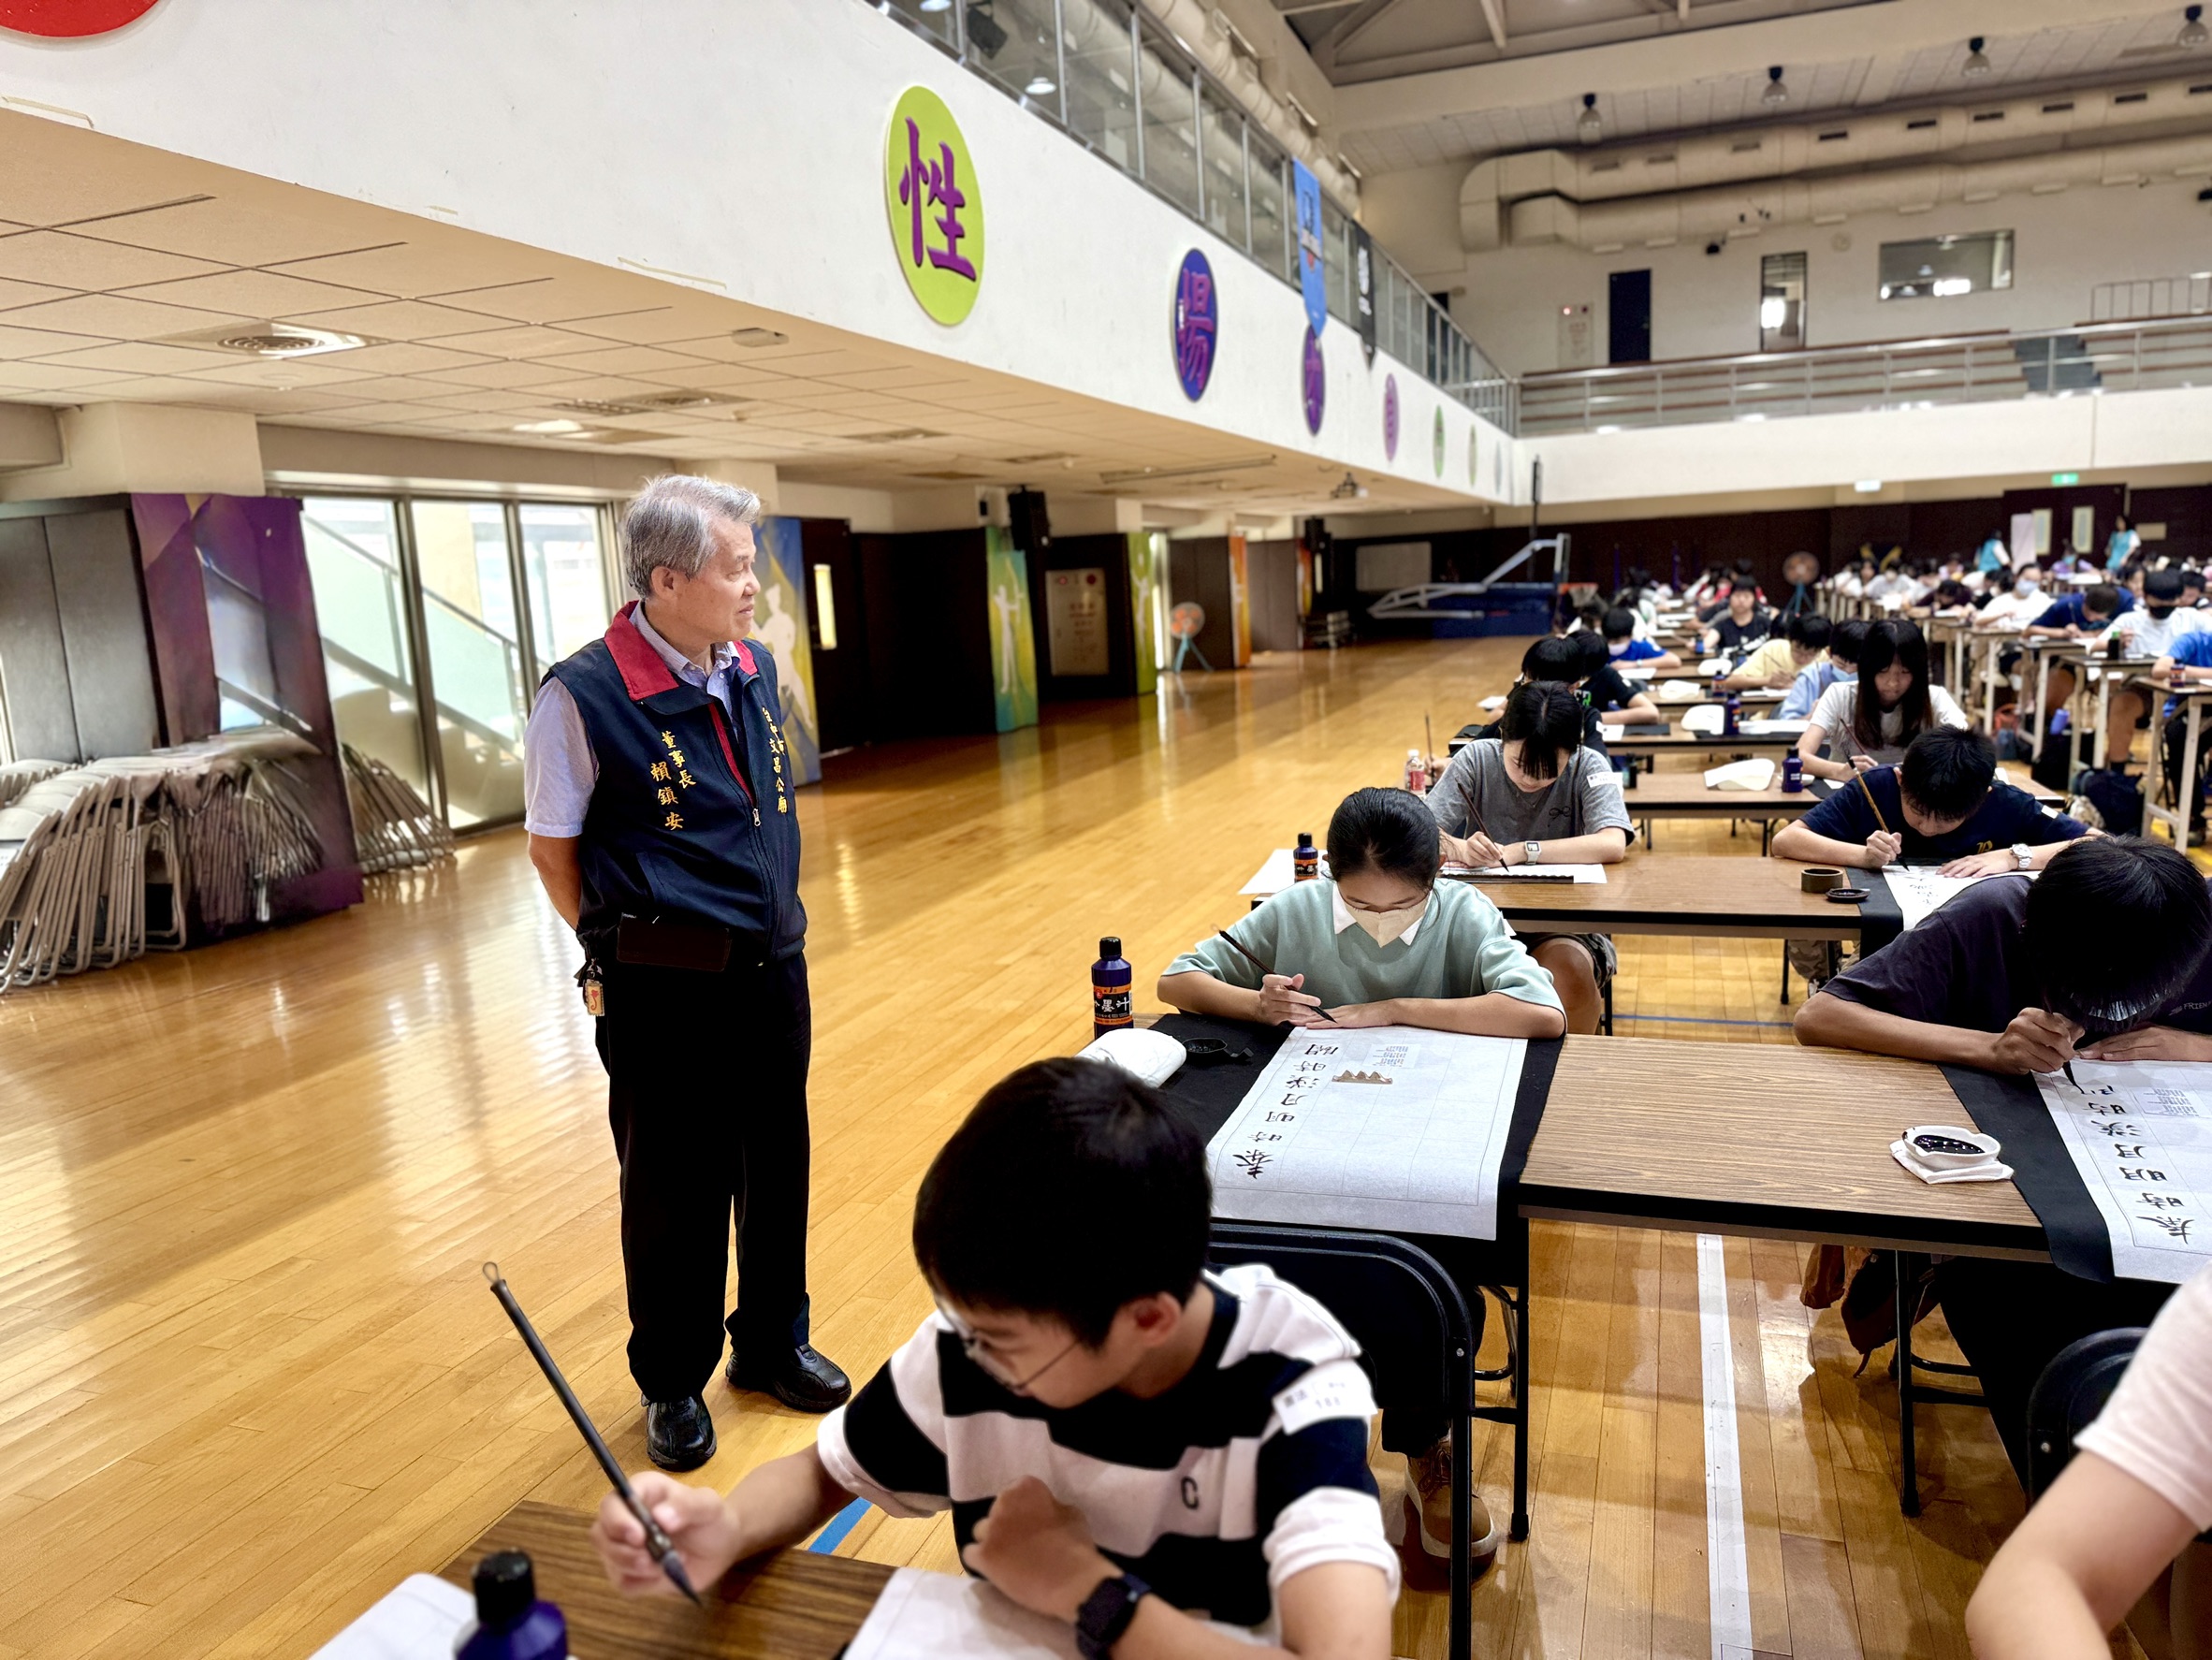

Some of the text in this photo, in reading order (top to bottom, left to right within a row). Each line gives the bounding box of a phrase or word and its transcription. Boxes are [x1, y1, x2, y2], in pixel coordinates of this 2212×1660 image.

[899, 116, 977, 283] 性
[649, 761, 685, 830] 賴鎮安
[661, 730, 696, 789] 董事長
[769, 737, 788, 814] 文昌公廟
[1231, 1042, 1339, 1180] 秦時明月漢時關
[1181, 1476, 1200, 1511] C
